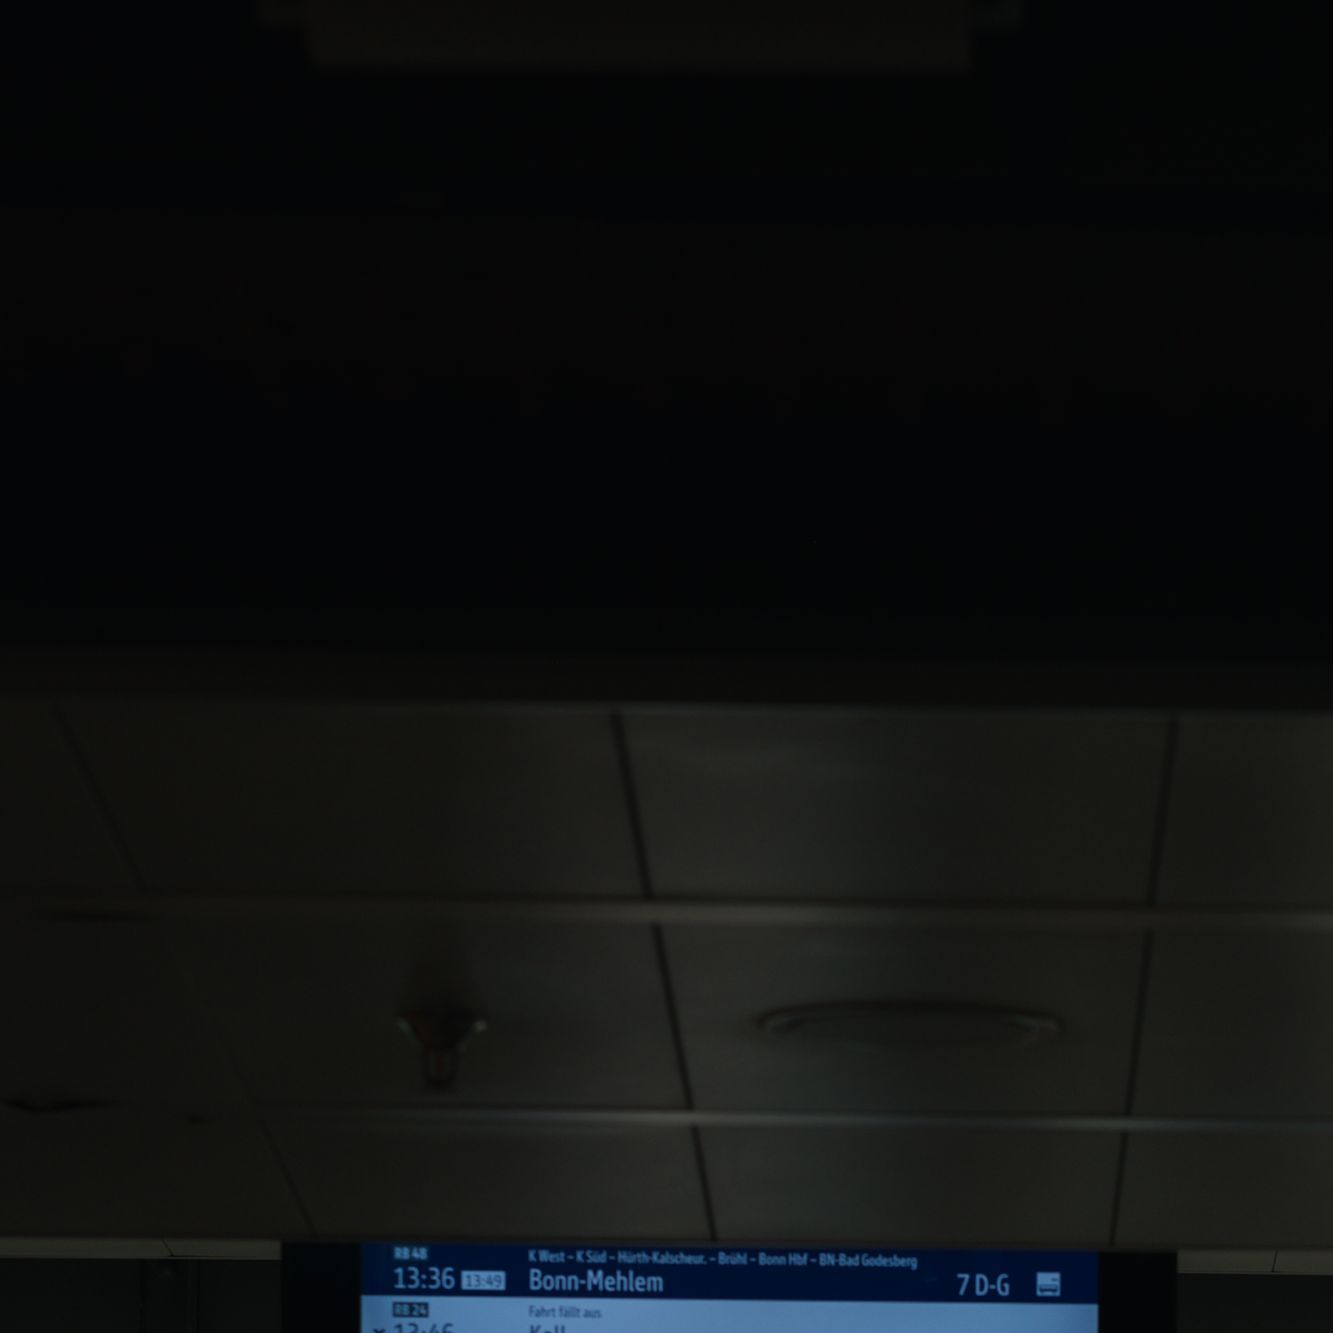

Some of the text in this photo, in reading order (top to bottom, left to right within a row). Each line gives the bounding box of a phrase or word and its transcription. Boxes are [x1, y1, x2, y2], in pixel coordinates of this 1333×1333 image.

[538, 1250, 565, 1263] West
[587, 1250, 607, 1264] Süd
[718, 1251, 747, 1266] Brühl
[759, 1253, 786, 1266] Bonn
[788, 1253, 808, 1266] Hbf
[861, 1255, 918, 1271] Godesberg
[394, 1267, 455, 1289] 13:36
[530, 1268, 664, 1292] Bonn-Mehlem
[957, 1274, 1009, 1296] 7 D-G
[529, 1306, 555, 1318] Fahrt
[558, 1306, 580, 1318] fällt
